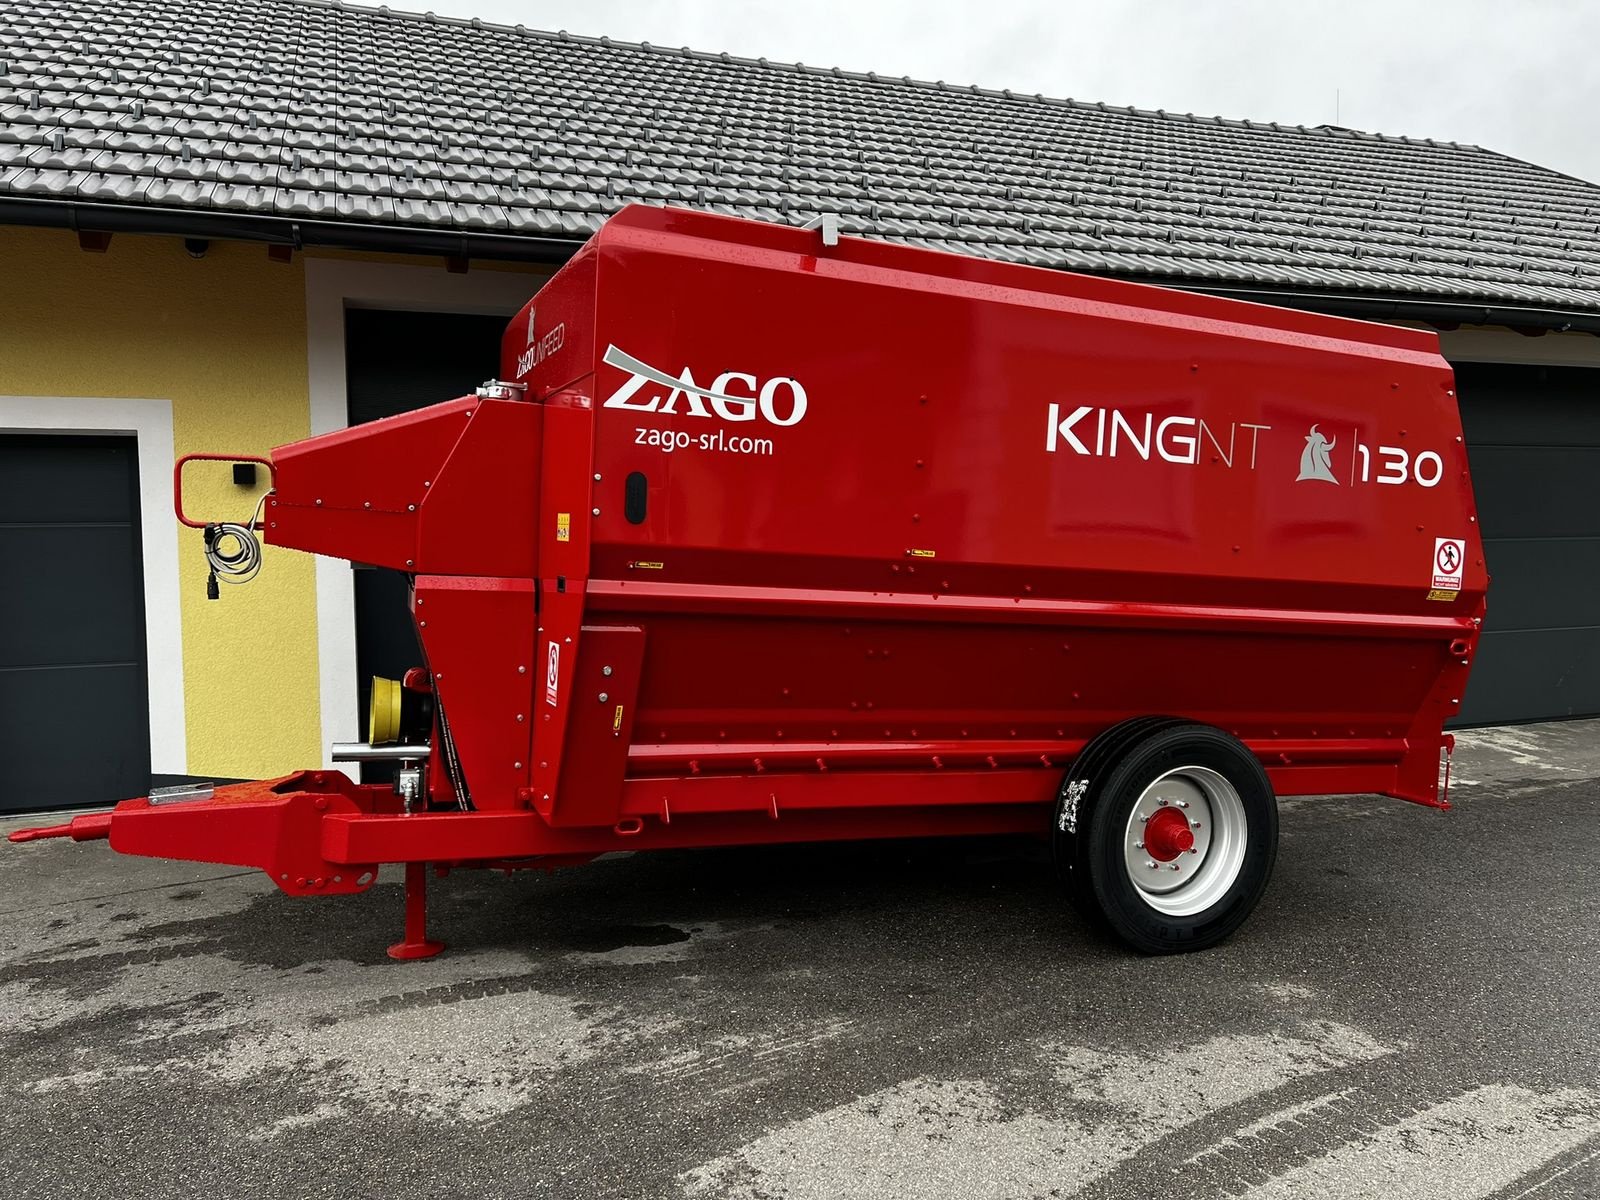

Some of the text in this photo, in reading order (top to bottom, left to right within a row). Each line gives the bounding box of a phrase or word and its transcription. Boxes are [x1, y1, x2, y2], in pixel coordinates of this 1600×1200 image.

[602, 343, 808, 426] ZAGO
[635, 427, 773, 455] zago-srl.com
[1358, 445, 1443, 488] 130
